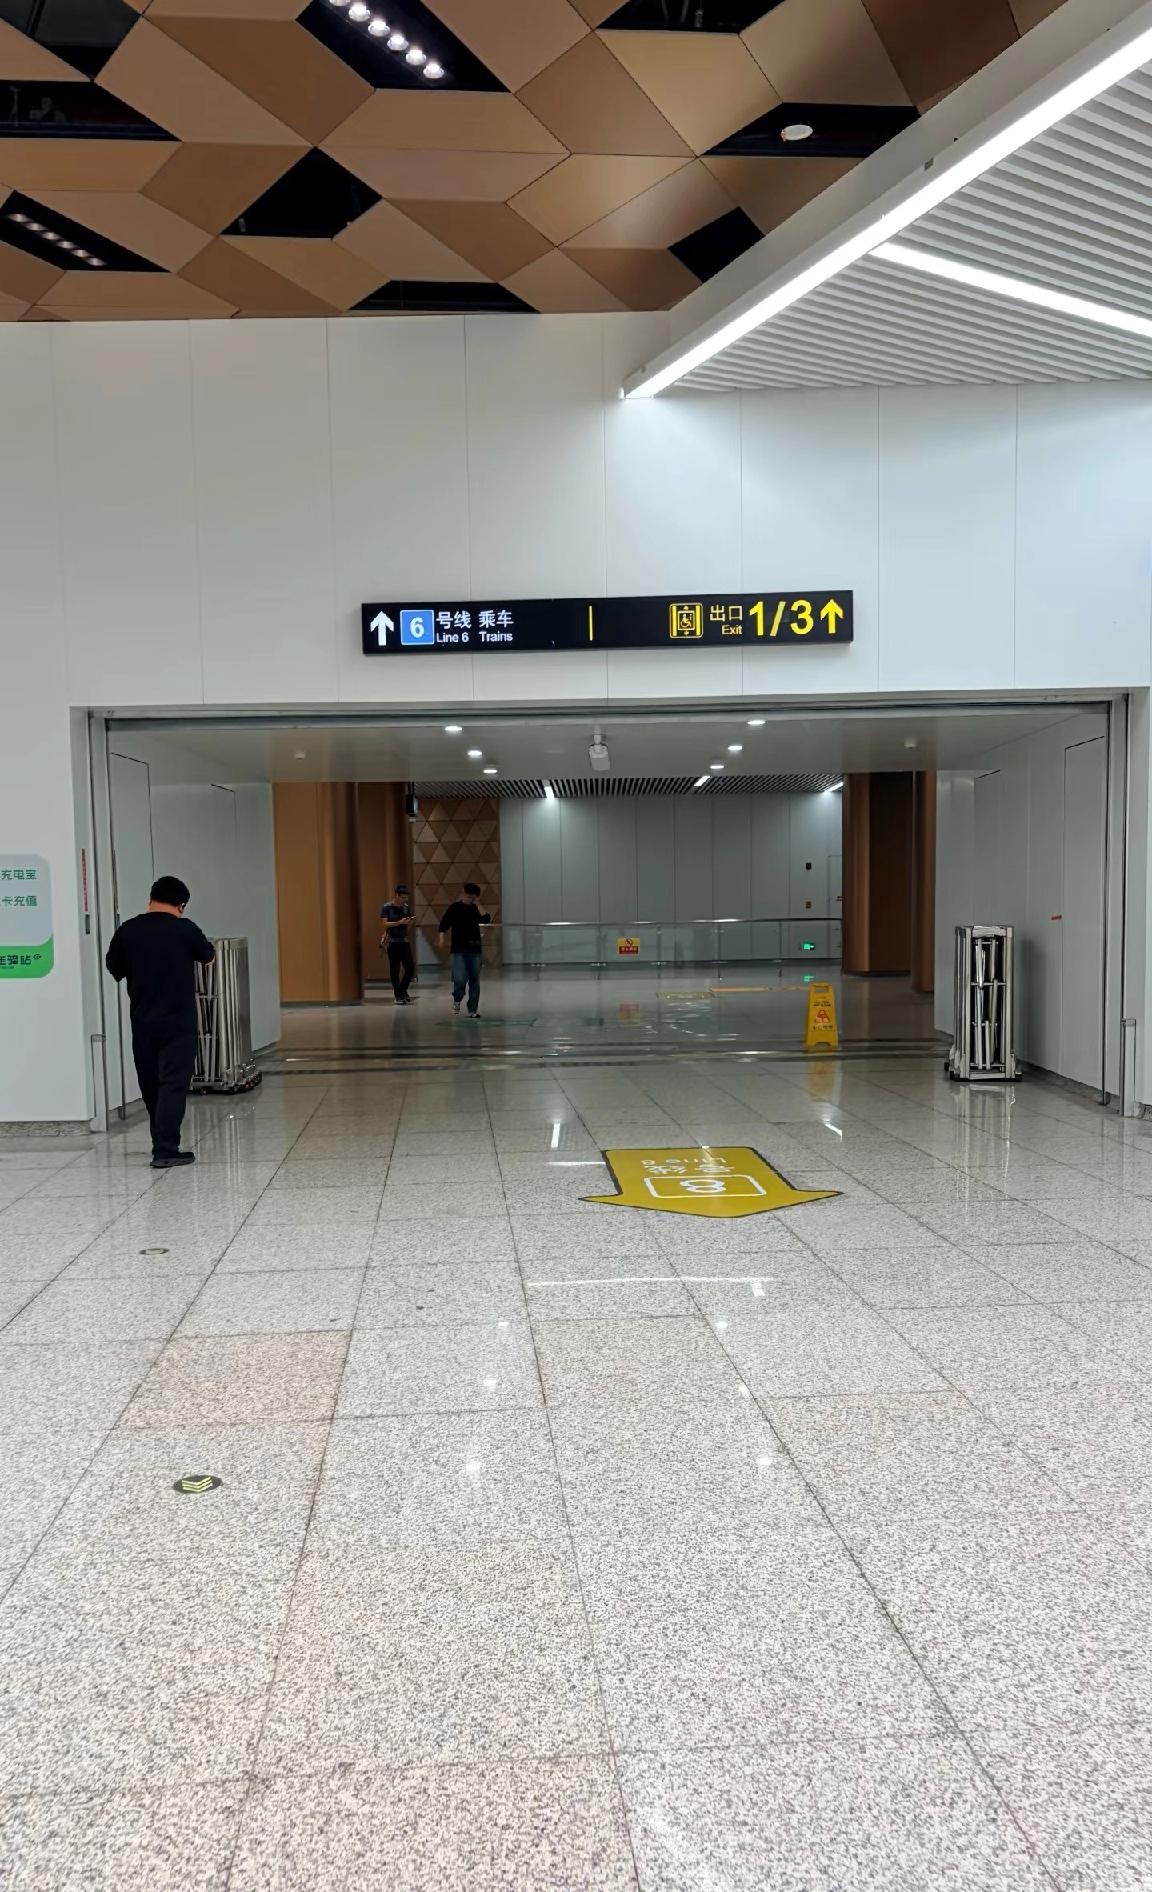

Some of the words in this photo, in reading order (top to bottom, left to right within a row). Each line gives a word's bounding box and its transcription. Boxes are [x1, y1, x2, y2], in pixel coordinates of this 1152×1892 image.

[709, 604, 743, 622] 出口
[749, 599, 814, 637] 1/3
[409, 617, 425, 638] 6
[436, 610, 472, 629] 号线
[478, 609, 514, 628] 乘车
[721, 625, 743, 635] Exit
[436, 632, 459, 643] Line
[461, 632, 469, 642] 6
[478, 631, 513, 643] Trains
[679, 1179, 727, 1193] 8
